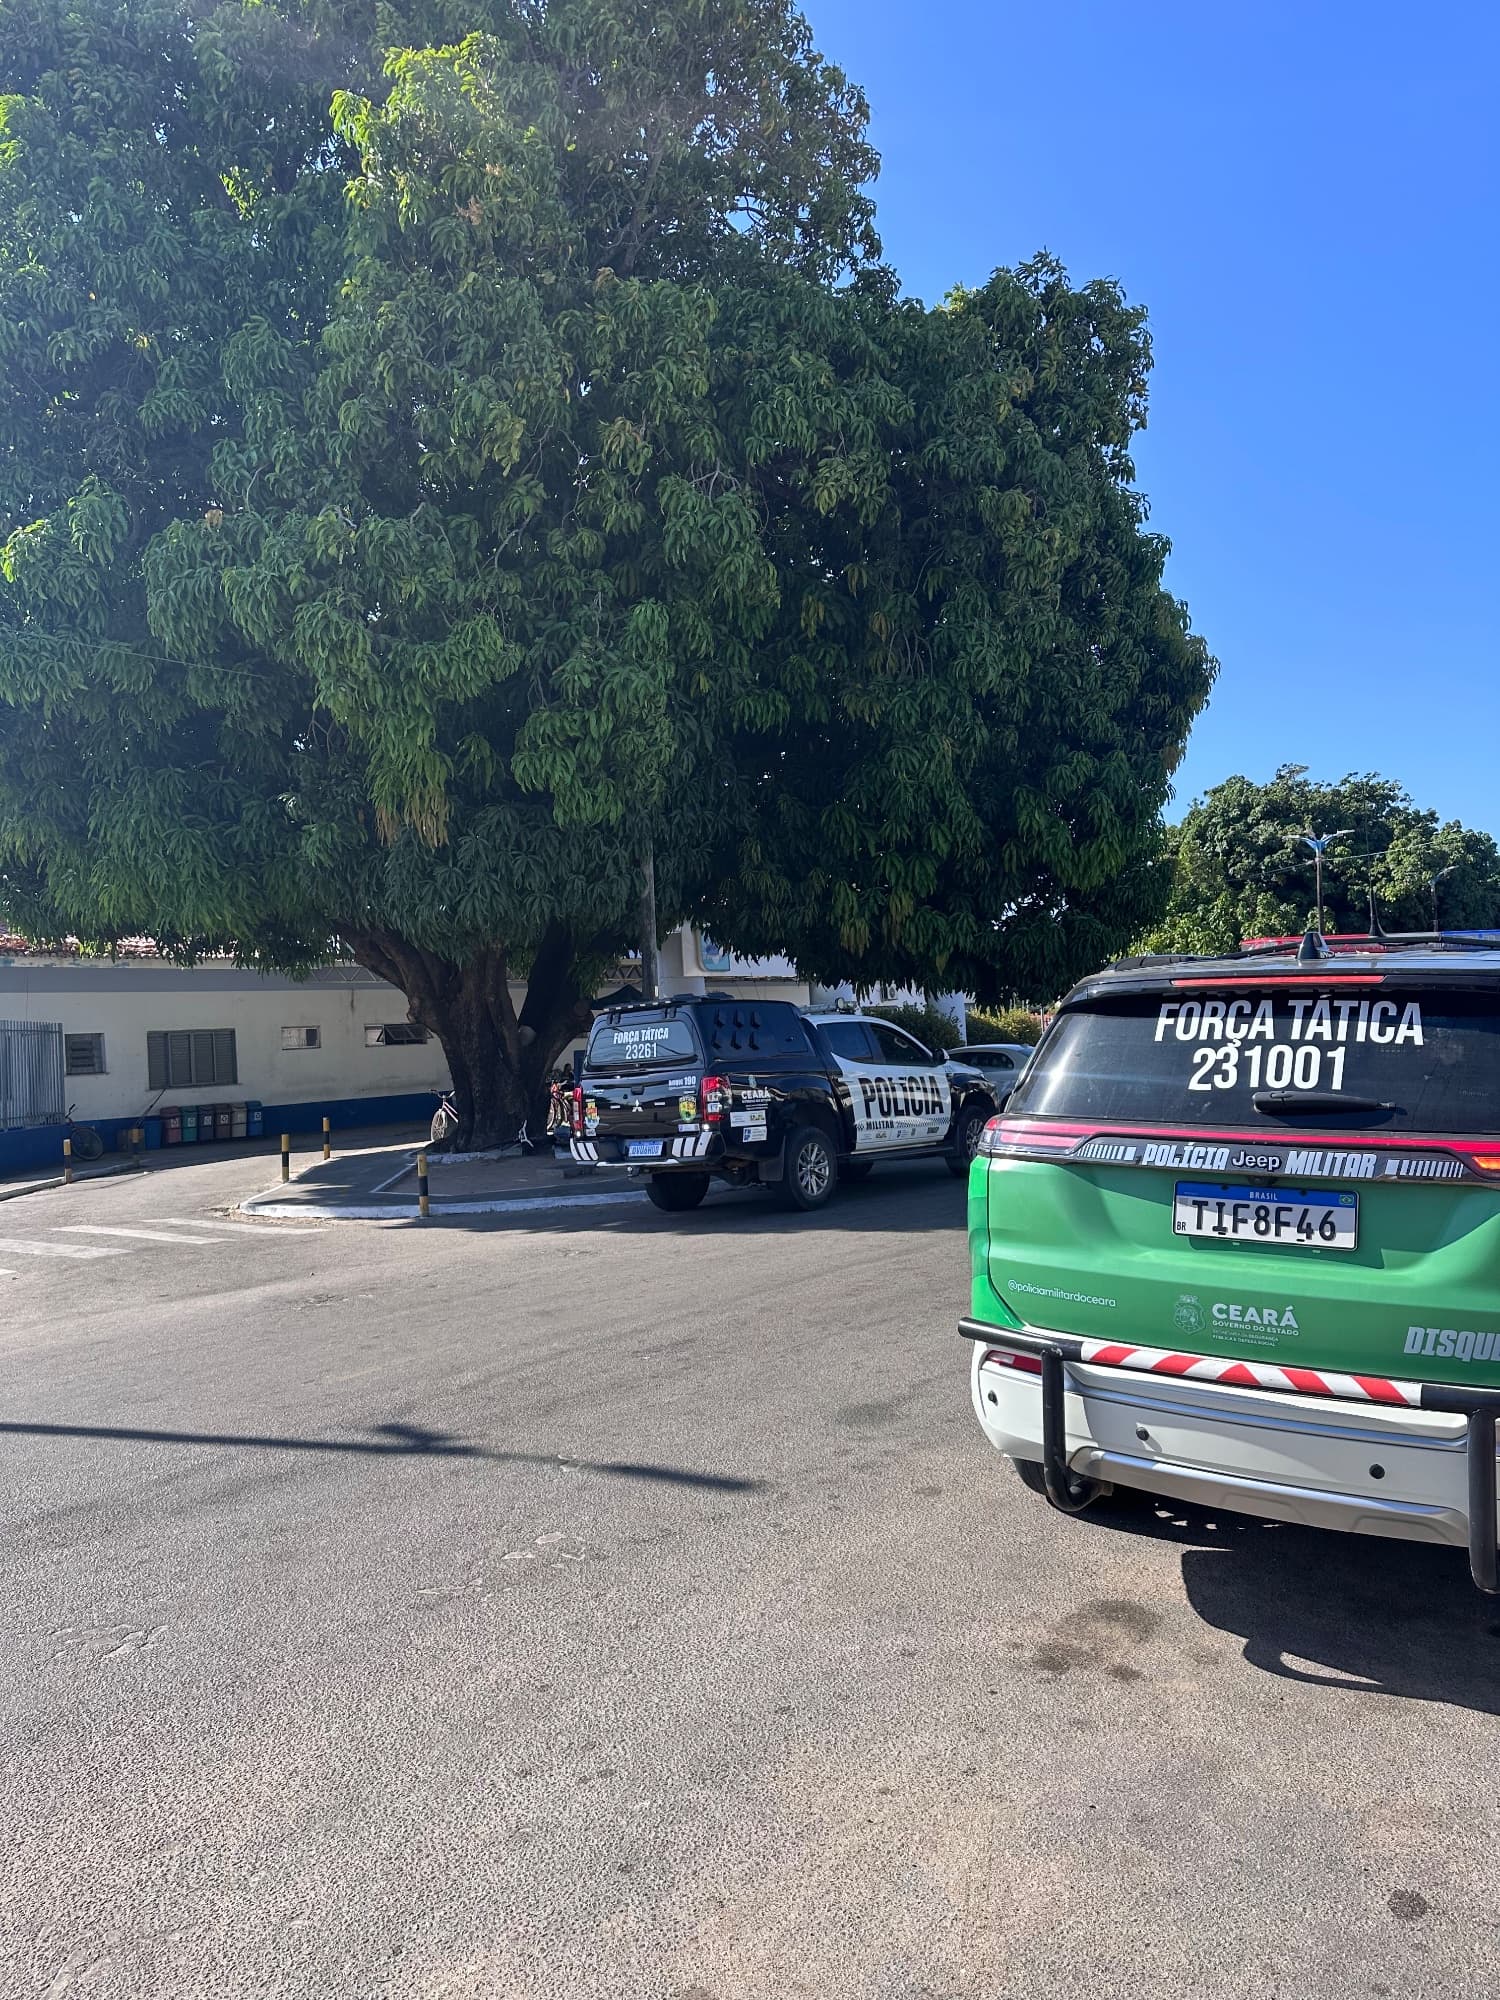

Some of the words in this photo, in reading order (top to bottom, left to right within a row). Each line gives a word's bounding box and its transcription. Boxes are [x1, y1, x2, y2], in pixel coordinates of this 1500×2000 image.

[1154, 999, 1275, 1048] FORÇA
[1287, 994, 1424, 1046] TÁTICA
[613, 1030, 640, 1045] FORÇA
[641, 1027, 669, 1041] TÁTICA
[625, 1043, 657, 1060] 23261
[1188, 1044, 1346, 1091] 231001
[684, 1076, 697, 1086] 190
[741, 1086, 771, 1100] CEARÁ
[866, 1120, 895, 1130] MILITAR
[1142, 1142, 1231, 1171] POLÍCIA
[1232, 1150, 1281, 1171] Jeep
[1284, 1150, 1377, 1178] MILITAR
[1249, 1191, 1278, 1201] BRASIL
[1176, 1221, 1187, 1231] BR
[1191, 1200, 1337, 1241] TIF8F46
[1008, 1279, 1117, 1307] @policiamilitardoceara
[1212, 1303, 1299, 1329] CEARÁ
[1212, 1320, 1251, 1330] GOVERNO
[1267, 1327, 1300, 1336] ESTADO
